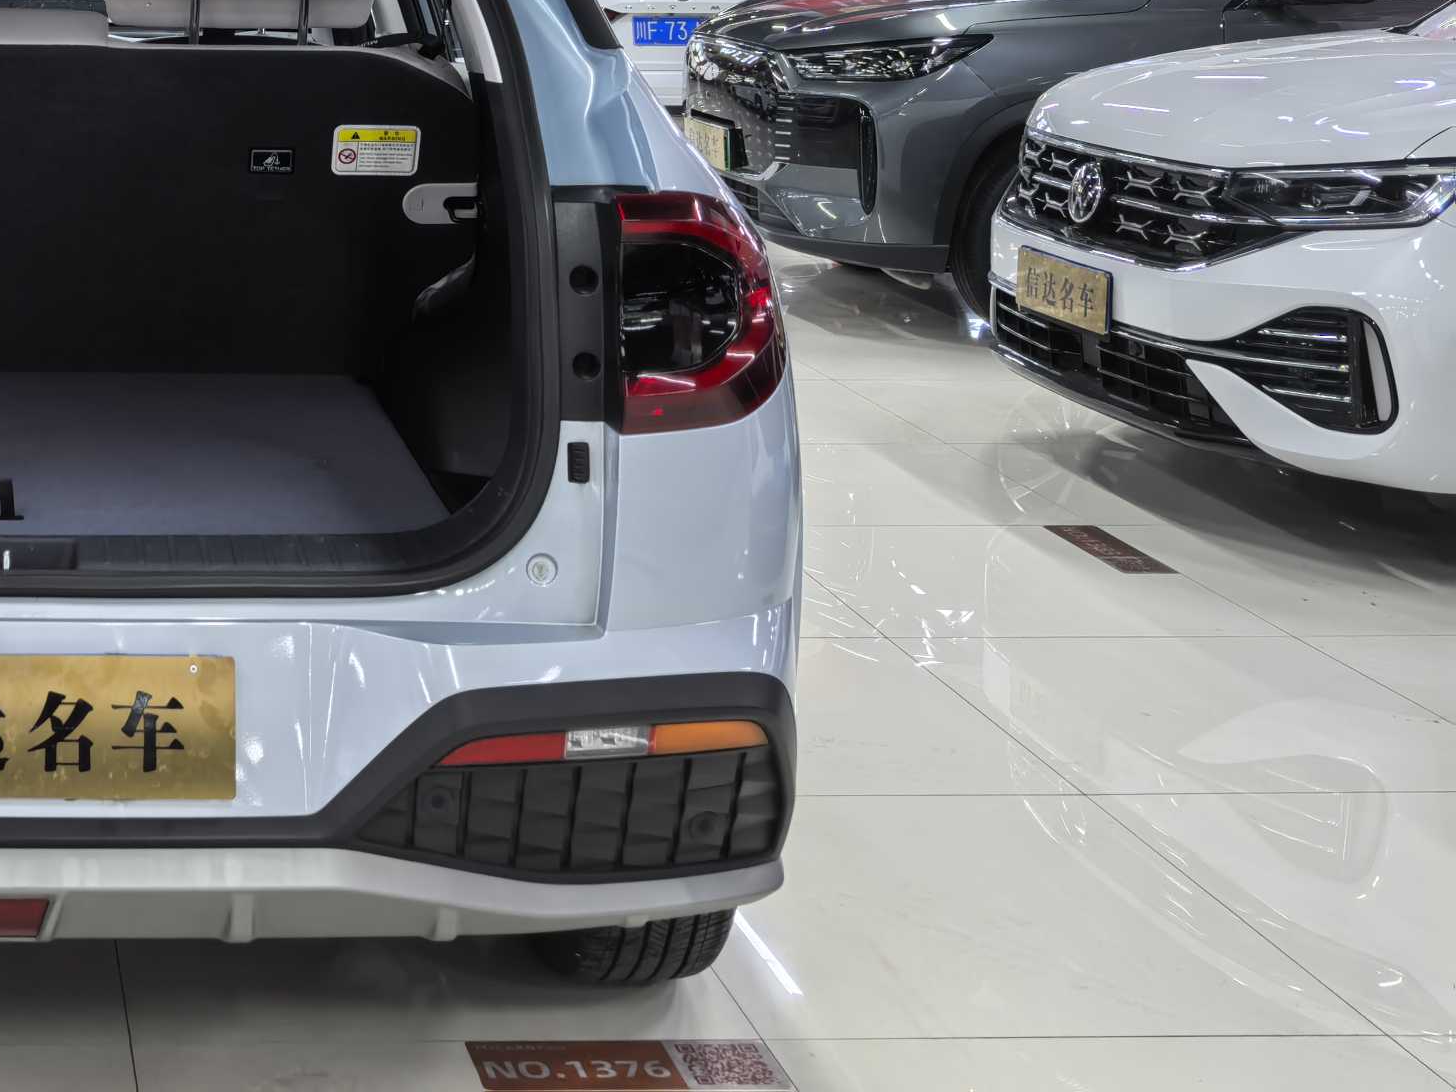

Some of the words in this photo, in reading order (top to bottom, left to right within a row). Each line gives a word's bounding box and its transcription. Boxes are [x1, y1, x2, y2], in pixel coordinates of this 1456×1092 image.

[636, 20, 700, 40] 川F·73
[1025, 267, 1095, 318] 信达名车
[485, 1060, 672, 1081] NO.1376
